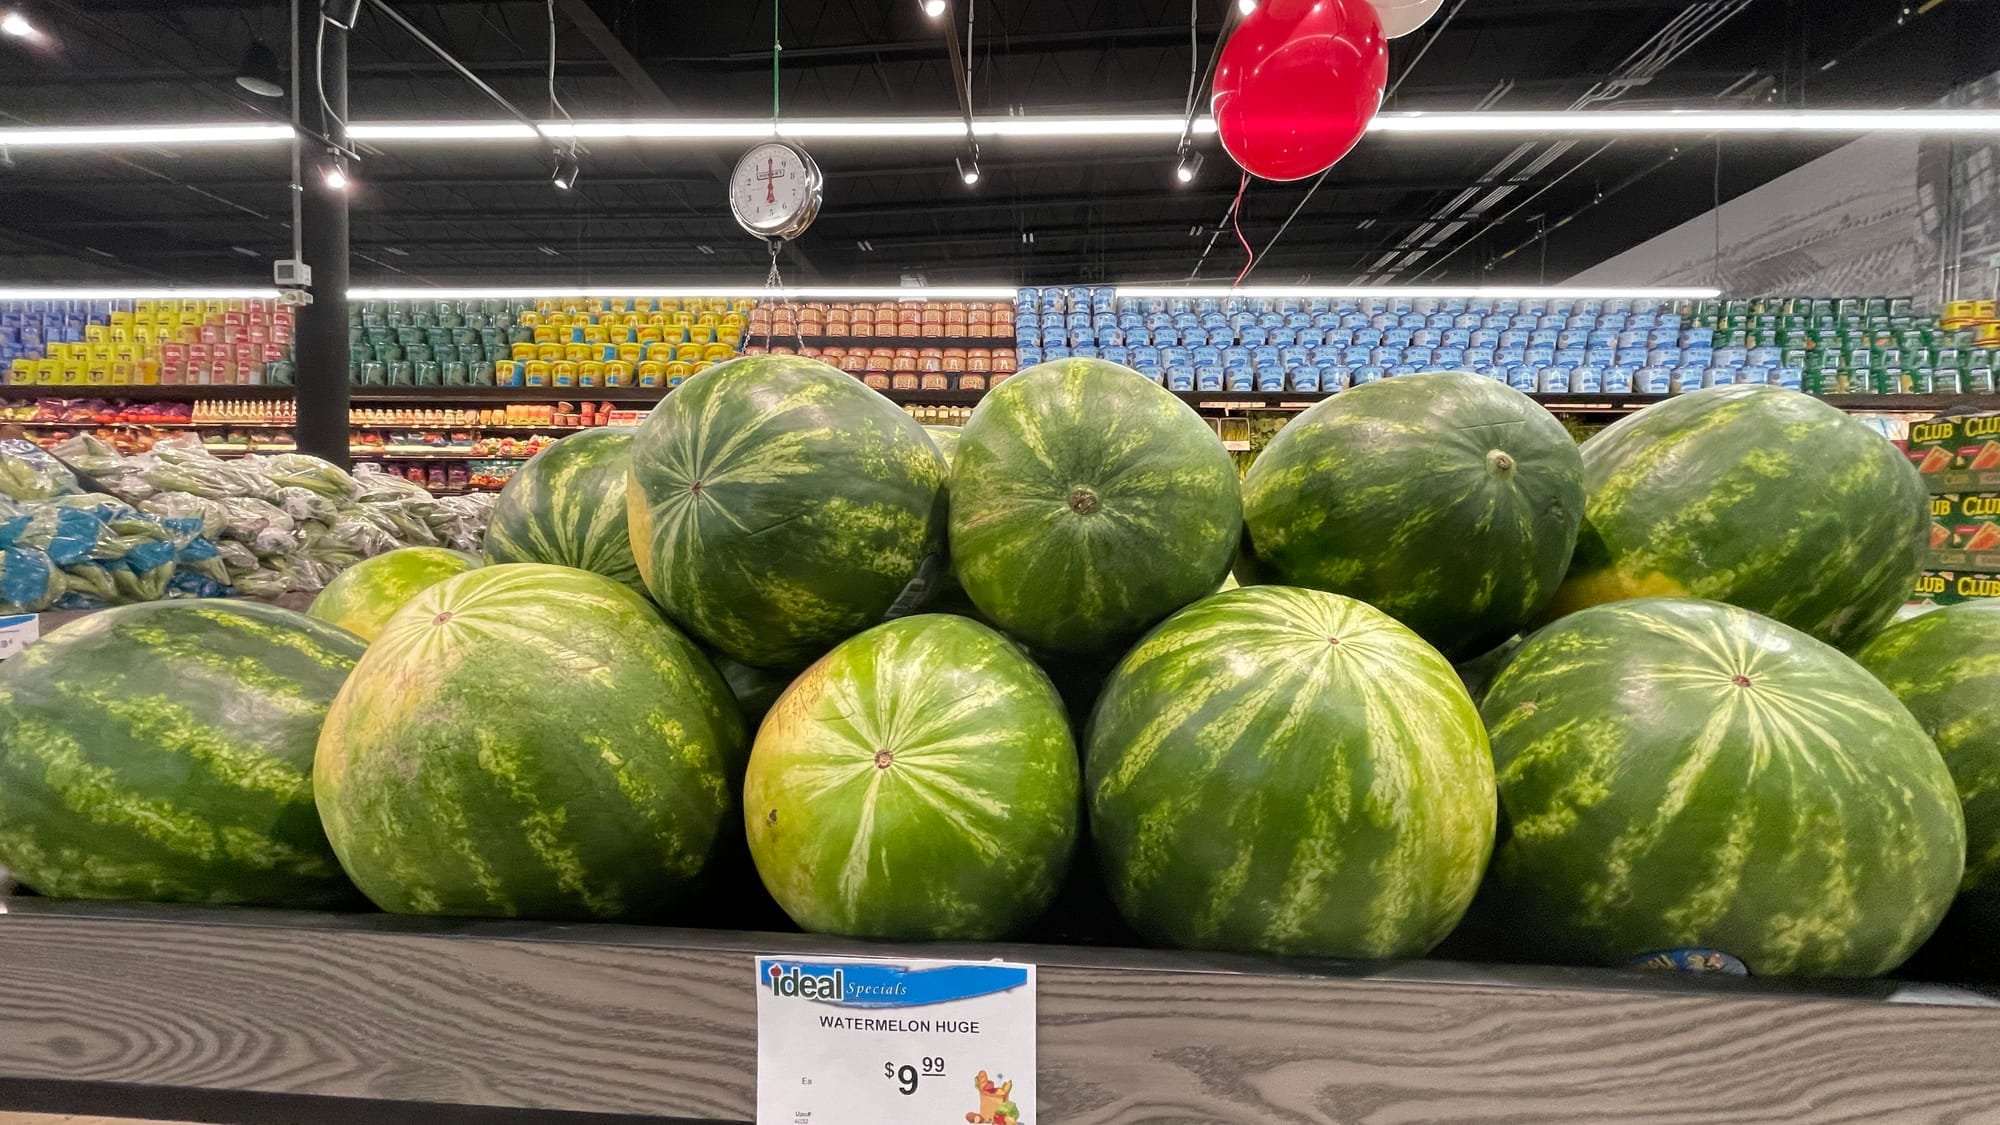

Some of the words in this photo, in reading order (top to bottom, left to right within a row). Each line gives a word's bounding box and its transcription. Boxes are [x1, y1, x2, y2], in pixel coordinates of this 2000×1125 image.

[1913, 423, 1953, 443] CLUB
[1915, 577, 1945, 593] LUB
[769, 964, 842, 1000] ideal
[846, 982, 907, 997] Specials
[819, 1016, 931, 1033] WATERMELON
[935, 1021, 981, 1034] HUGE
[801, 1076, 813, 1085] Ea
